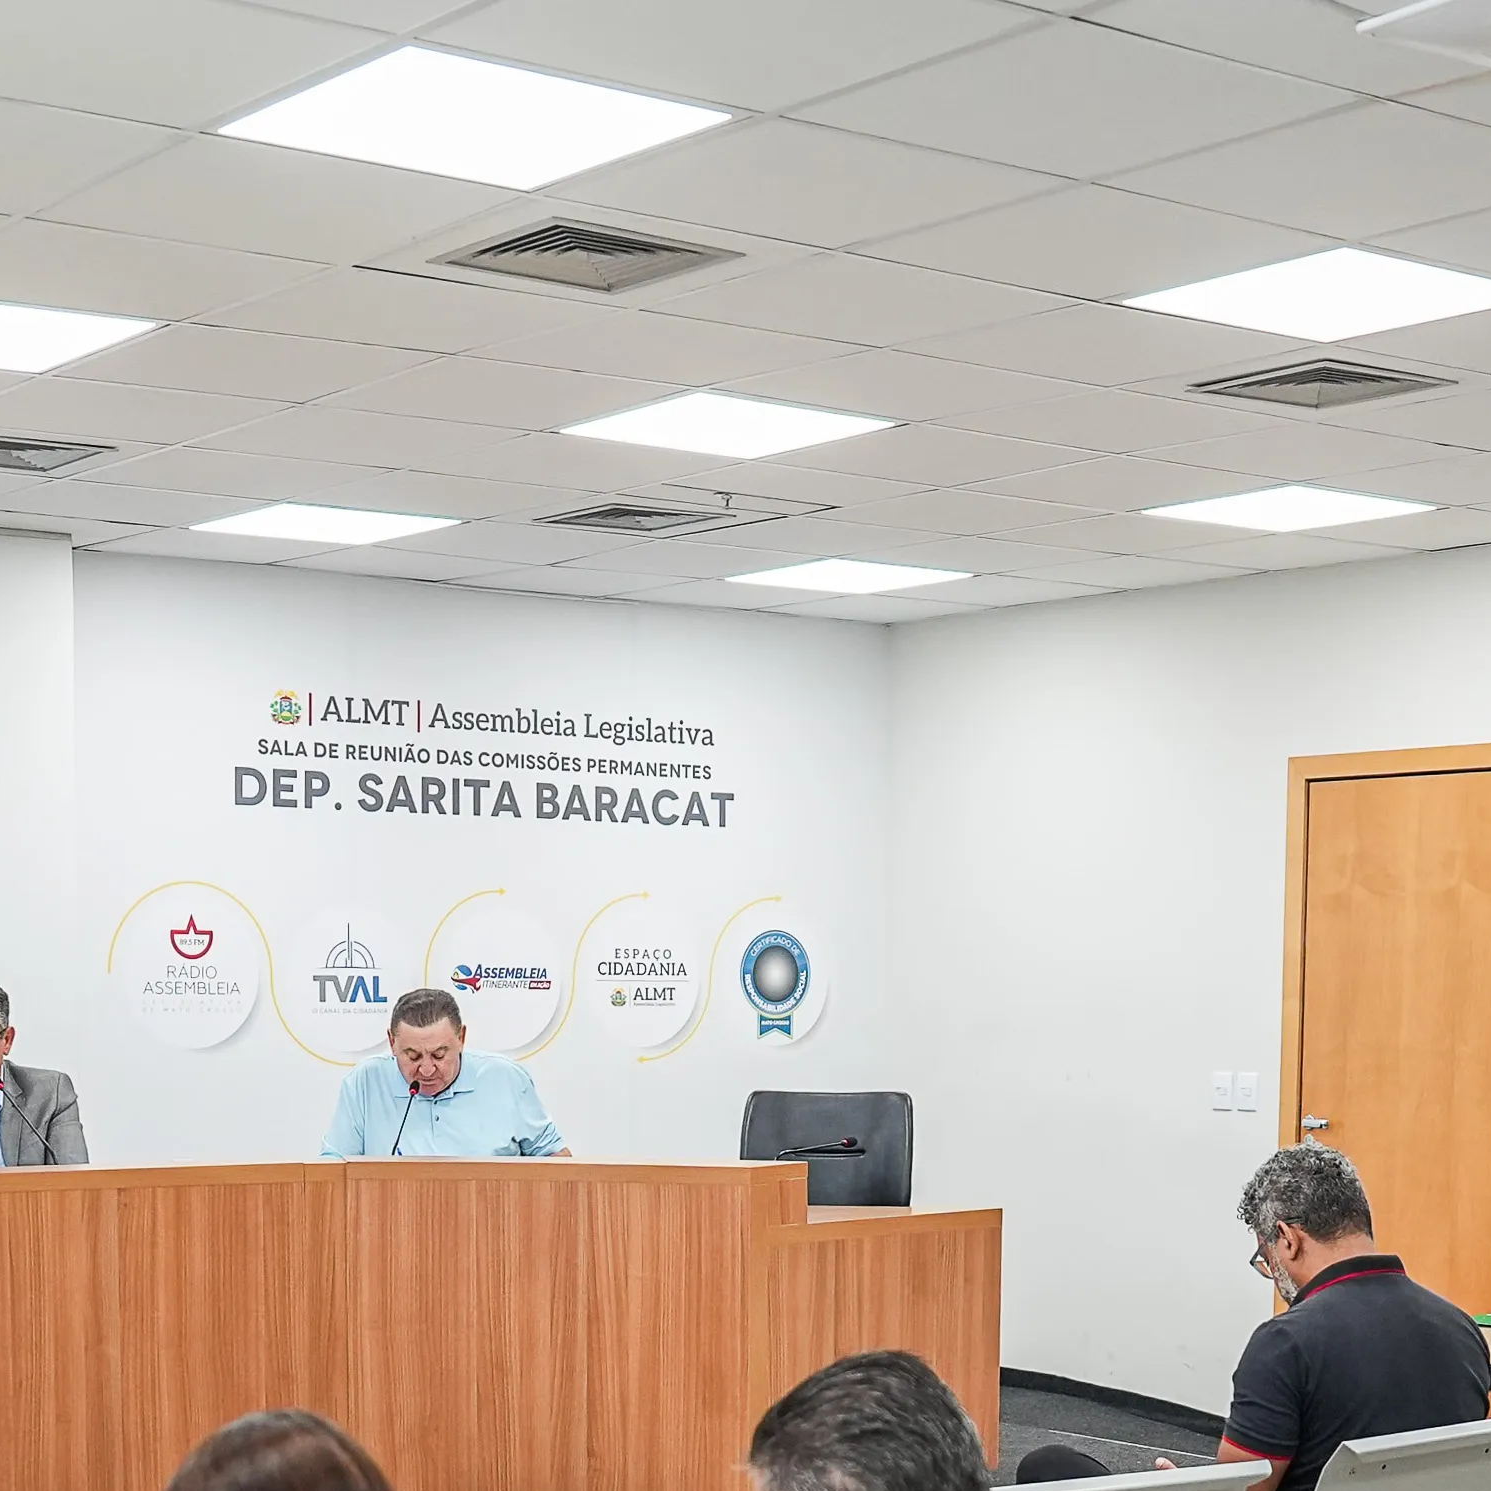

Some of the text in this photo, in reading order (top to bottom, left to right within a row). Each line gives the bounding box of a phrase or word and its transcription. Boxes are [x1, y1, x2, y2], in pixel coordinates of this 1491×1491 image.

[320, 695, 715, 747] ALMT Assembleia Legislativa
[257, 739, 712, 780] SALA DE REUNIÃO DAS COMISSÕES PERMANENTES
[234, 766, 735, 828] DEP. SARITA BARACAT
[614, 948, 672, 961] ESPAÇO
[750, 935, 791, 957] CERTIFICADO
[166, 962, 217, 979] RÁDIO
[473, 964, 547, 979] ASSEMBLEIA
[597, 961, 687, 976] CIDADANIA
[143, 981, 241, 995] ASSEMBLEIA
[313, 975, 388, 1003] TVAL
[633, 987, 676, 1001] ALMT
